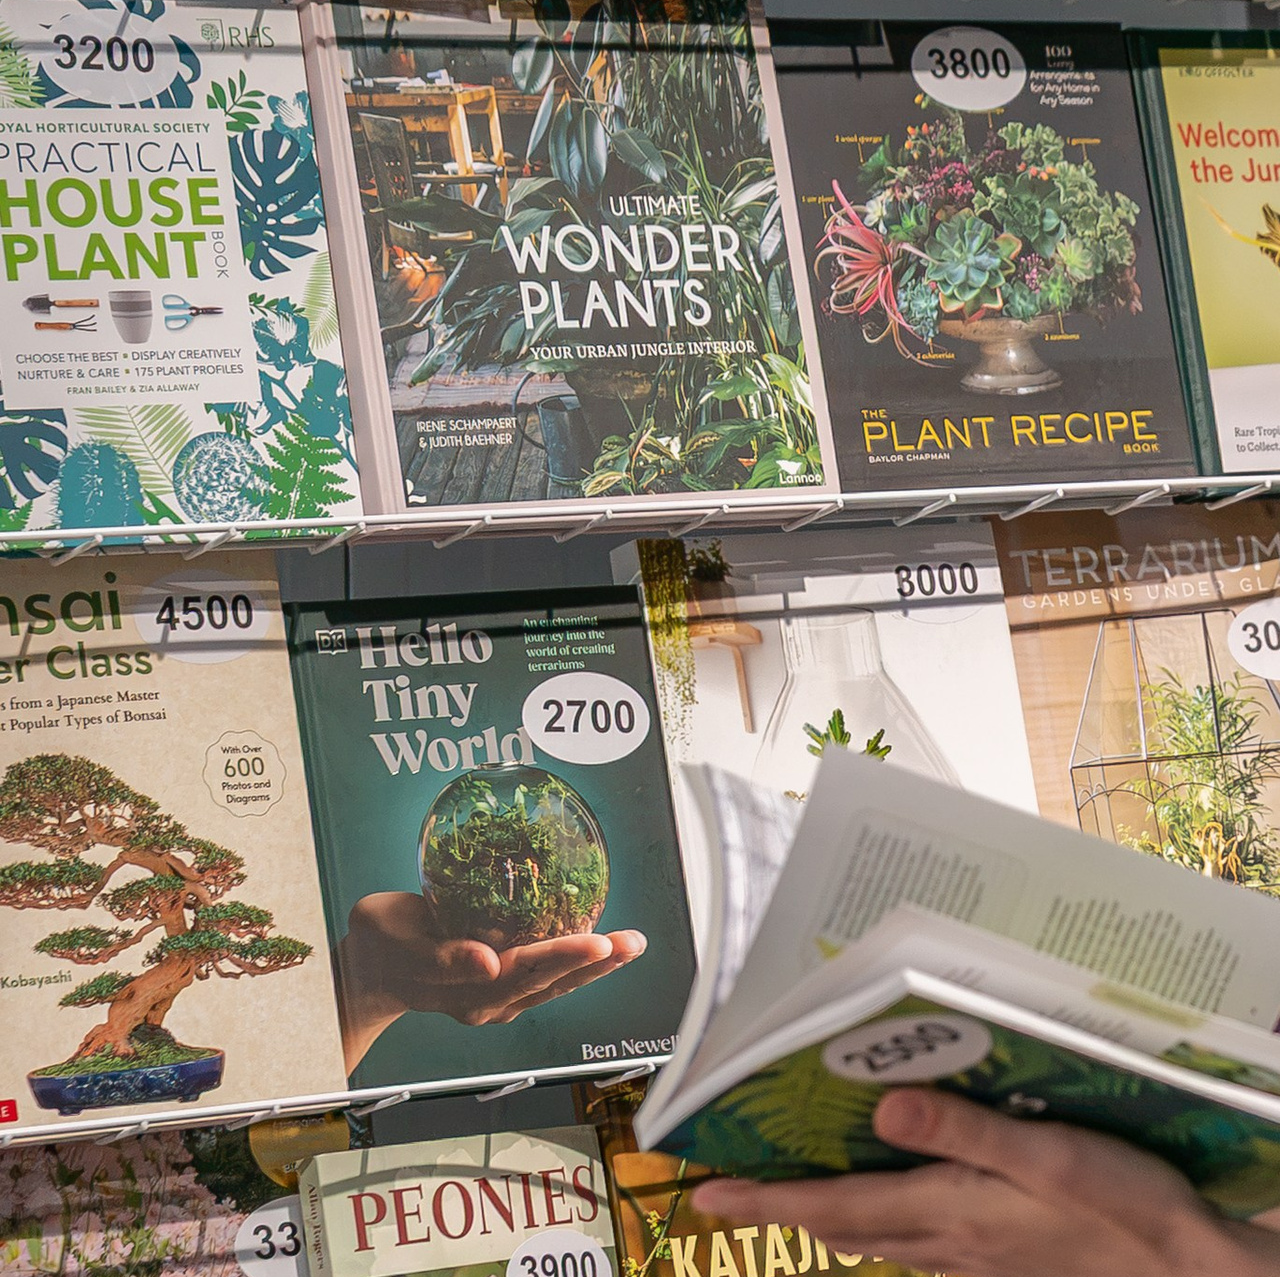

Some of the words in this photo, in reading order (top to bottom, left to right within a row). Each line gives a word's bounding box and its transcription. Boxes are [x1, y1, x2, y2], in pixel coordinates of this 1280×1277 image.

[228, 26, 276, 49] RHS
[53, 33, 156, 74] 3200
[927, 47, 1011, 80] 3800
[35, 122, 150, 134] HORTICULTURAL
[152, 122, 211, 134] SOCIETY
[0, 141, 217, 174] PRACTICAL
[1190, 157, 1234, 184] the
[0, 177, 226, 228] HOUSE
[609, 194, 702, 218] ULTIMATE
[2, 231, 207, 282] PLANT
[211, 230, 230, 279] BOOK
[501, 223, 745, 275] WONDER
[518, 277, 712, 331] PLANTS
[15, 351, 68, 364] CHOOSE
[131, 348, 176, 362] DISPLAY
[177, 347, 242, 362] CREATIVELY
[530, 346, 574, 362] YOUR
[576, 344, 628, 360] URBAN
[630, 342, 686, 359] JUNGLE
[686, 339, 757, 356] INTERIOR
[17, 367, 73, 380] NURTURE
[193, 363, 244, 377] PROFILES
[863, 417, 996, 454] PLANT
[1010, 410, 1159, 448] RECIPE
[1234, 426, 1255, 438] Rare
[868, 453, 905, 465] BAYLOR
[905, 452, 951, 464] CHAPMAN
[895, 562, 978, 597] 3000
[1022, 587, 1134, 611] GARDENS
[1146, 579, 1226, 601] UNDER
[156, 593, 254, 632] 4500
[46, 640, 153, 682] Class
[355, 622, 493, 671] Hello
[528, 658, 586, 672] terrariums
[56, 693, 114, 713] Japanese
[116, 688, 161, 704] Master
[362, 674, 479, 727] Tiny
[10, 716, 61, 734] Popular
[63, 713, 103, 731] Types
[123, 707, 167, 723] Bonsai
[542, 699, 635, 733] 2700
[369, 723, 538, 776] World
[224, 756, 265, 778] 600
[226, 791, 272, 805] Diagrams
[0, 970, 73, 991] Kobayashi
[581, 1042, 618, 1061] Ben
[348, 1164, 602, 1253] PEONIES
